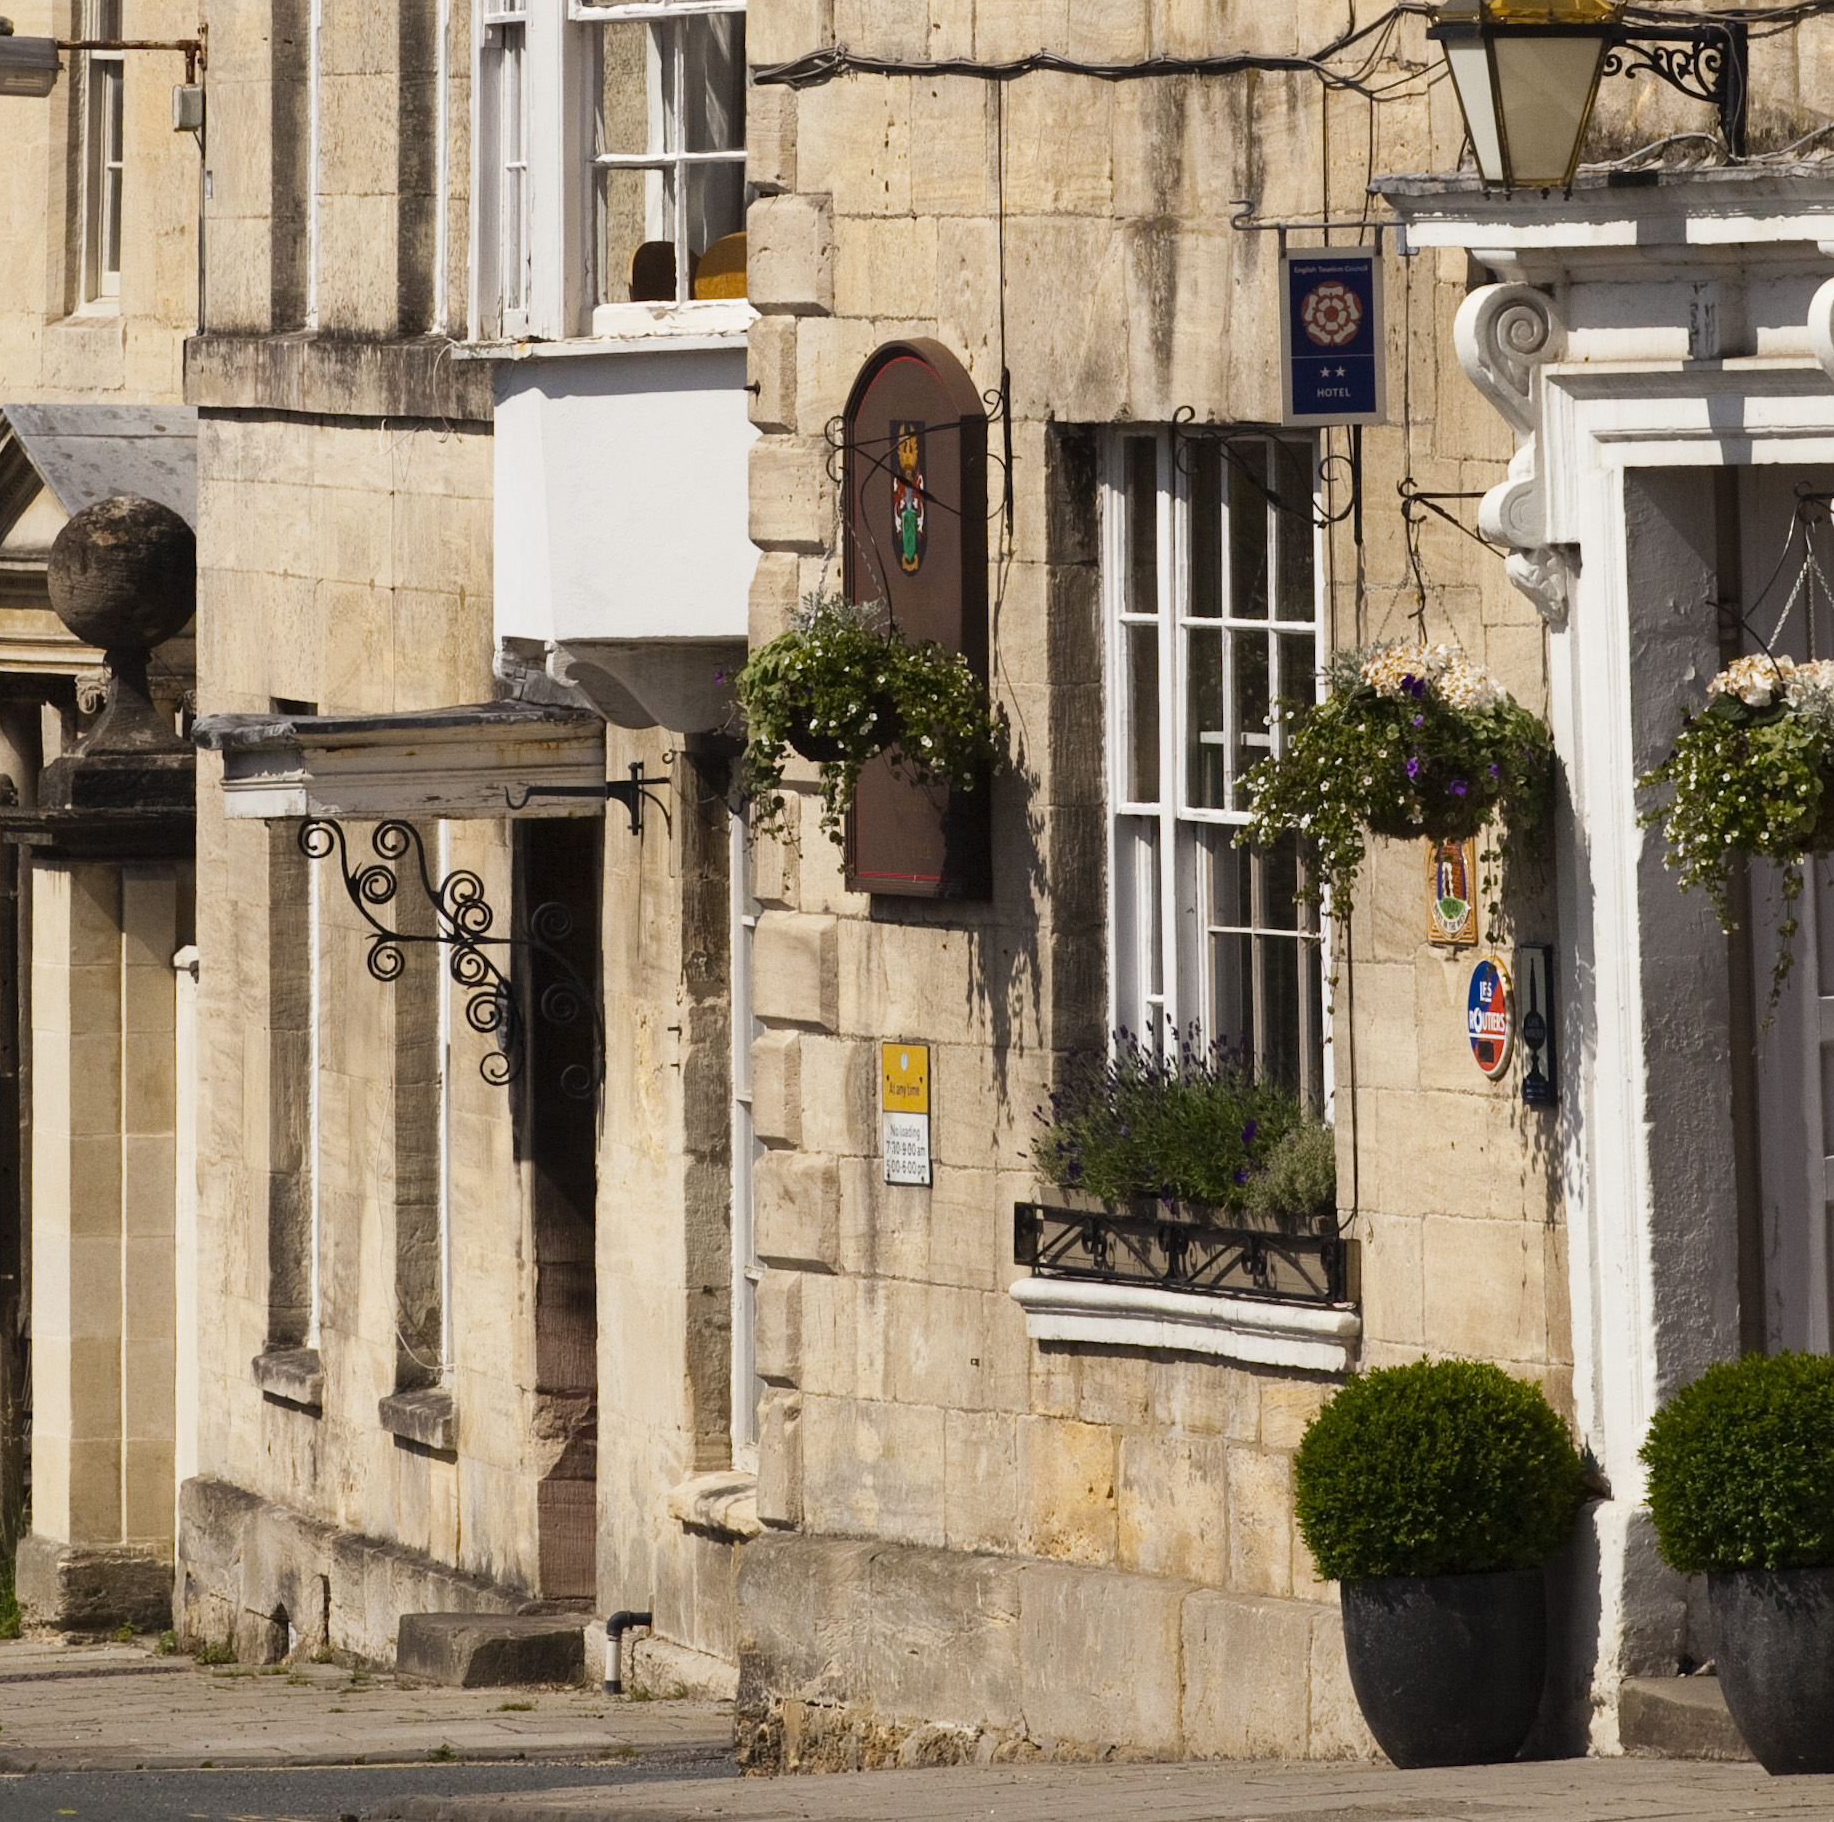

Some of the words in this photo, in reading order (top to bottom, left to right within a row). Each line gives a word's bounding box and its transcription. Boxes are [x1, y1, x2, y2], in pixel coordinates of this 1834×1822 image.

[1317, 387, 1351, 398] HOTEL
[1469, 1007, 1505, 1033] ROUTIERS
[890, 1124, 898, 1137] No
[899, 1124, 920, 1141] loading
